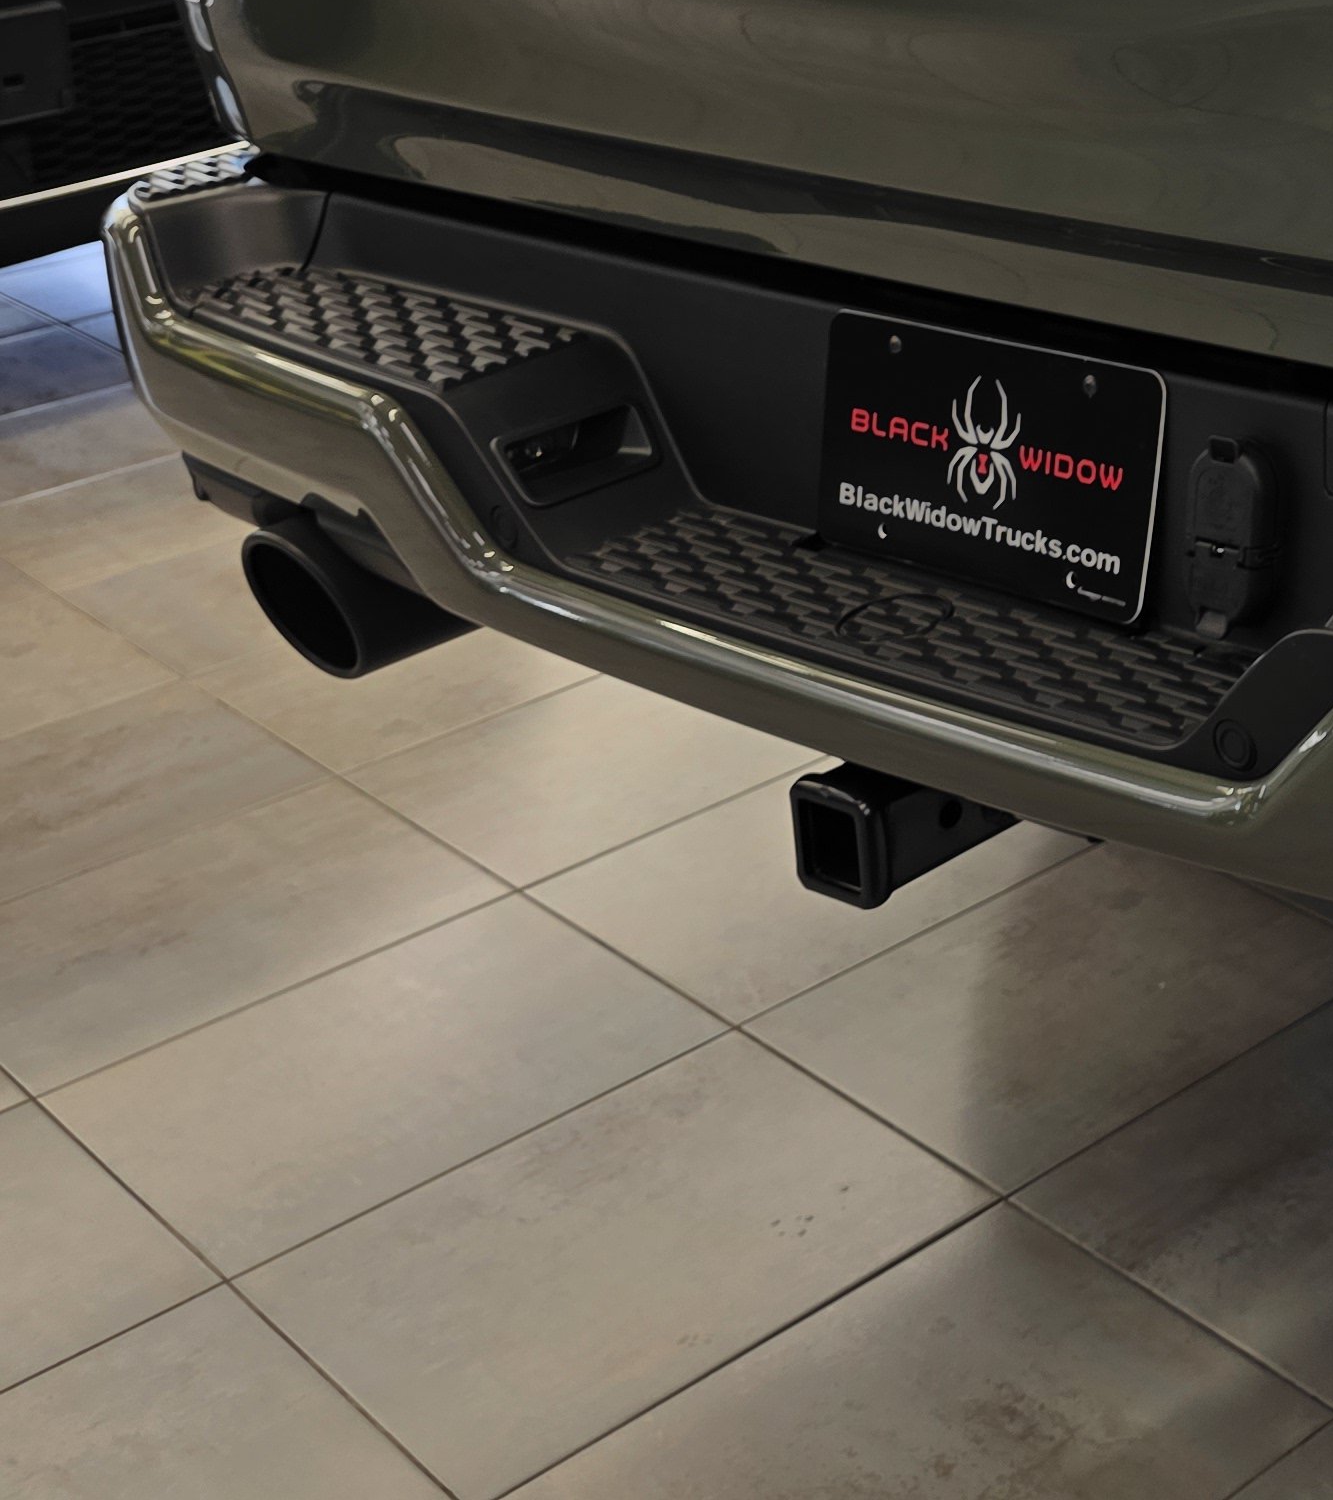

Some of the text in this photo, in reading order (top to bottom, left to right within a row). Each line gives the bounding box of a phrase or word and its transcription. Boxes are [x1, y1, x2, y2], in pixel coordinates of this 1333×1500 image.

[850, 407, 1124, 491] BLACK WIDOW
[838, 480, 1122, 575] BlackWidowTrucks.com
